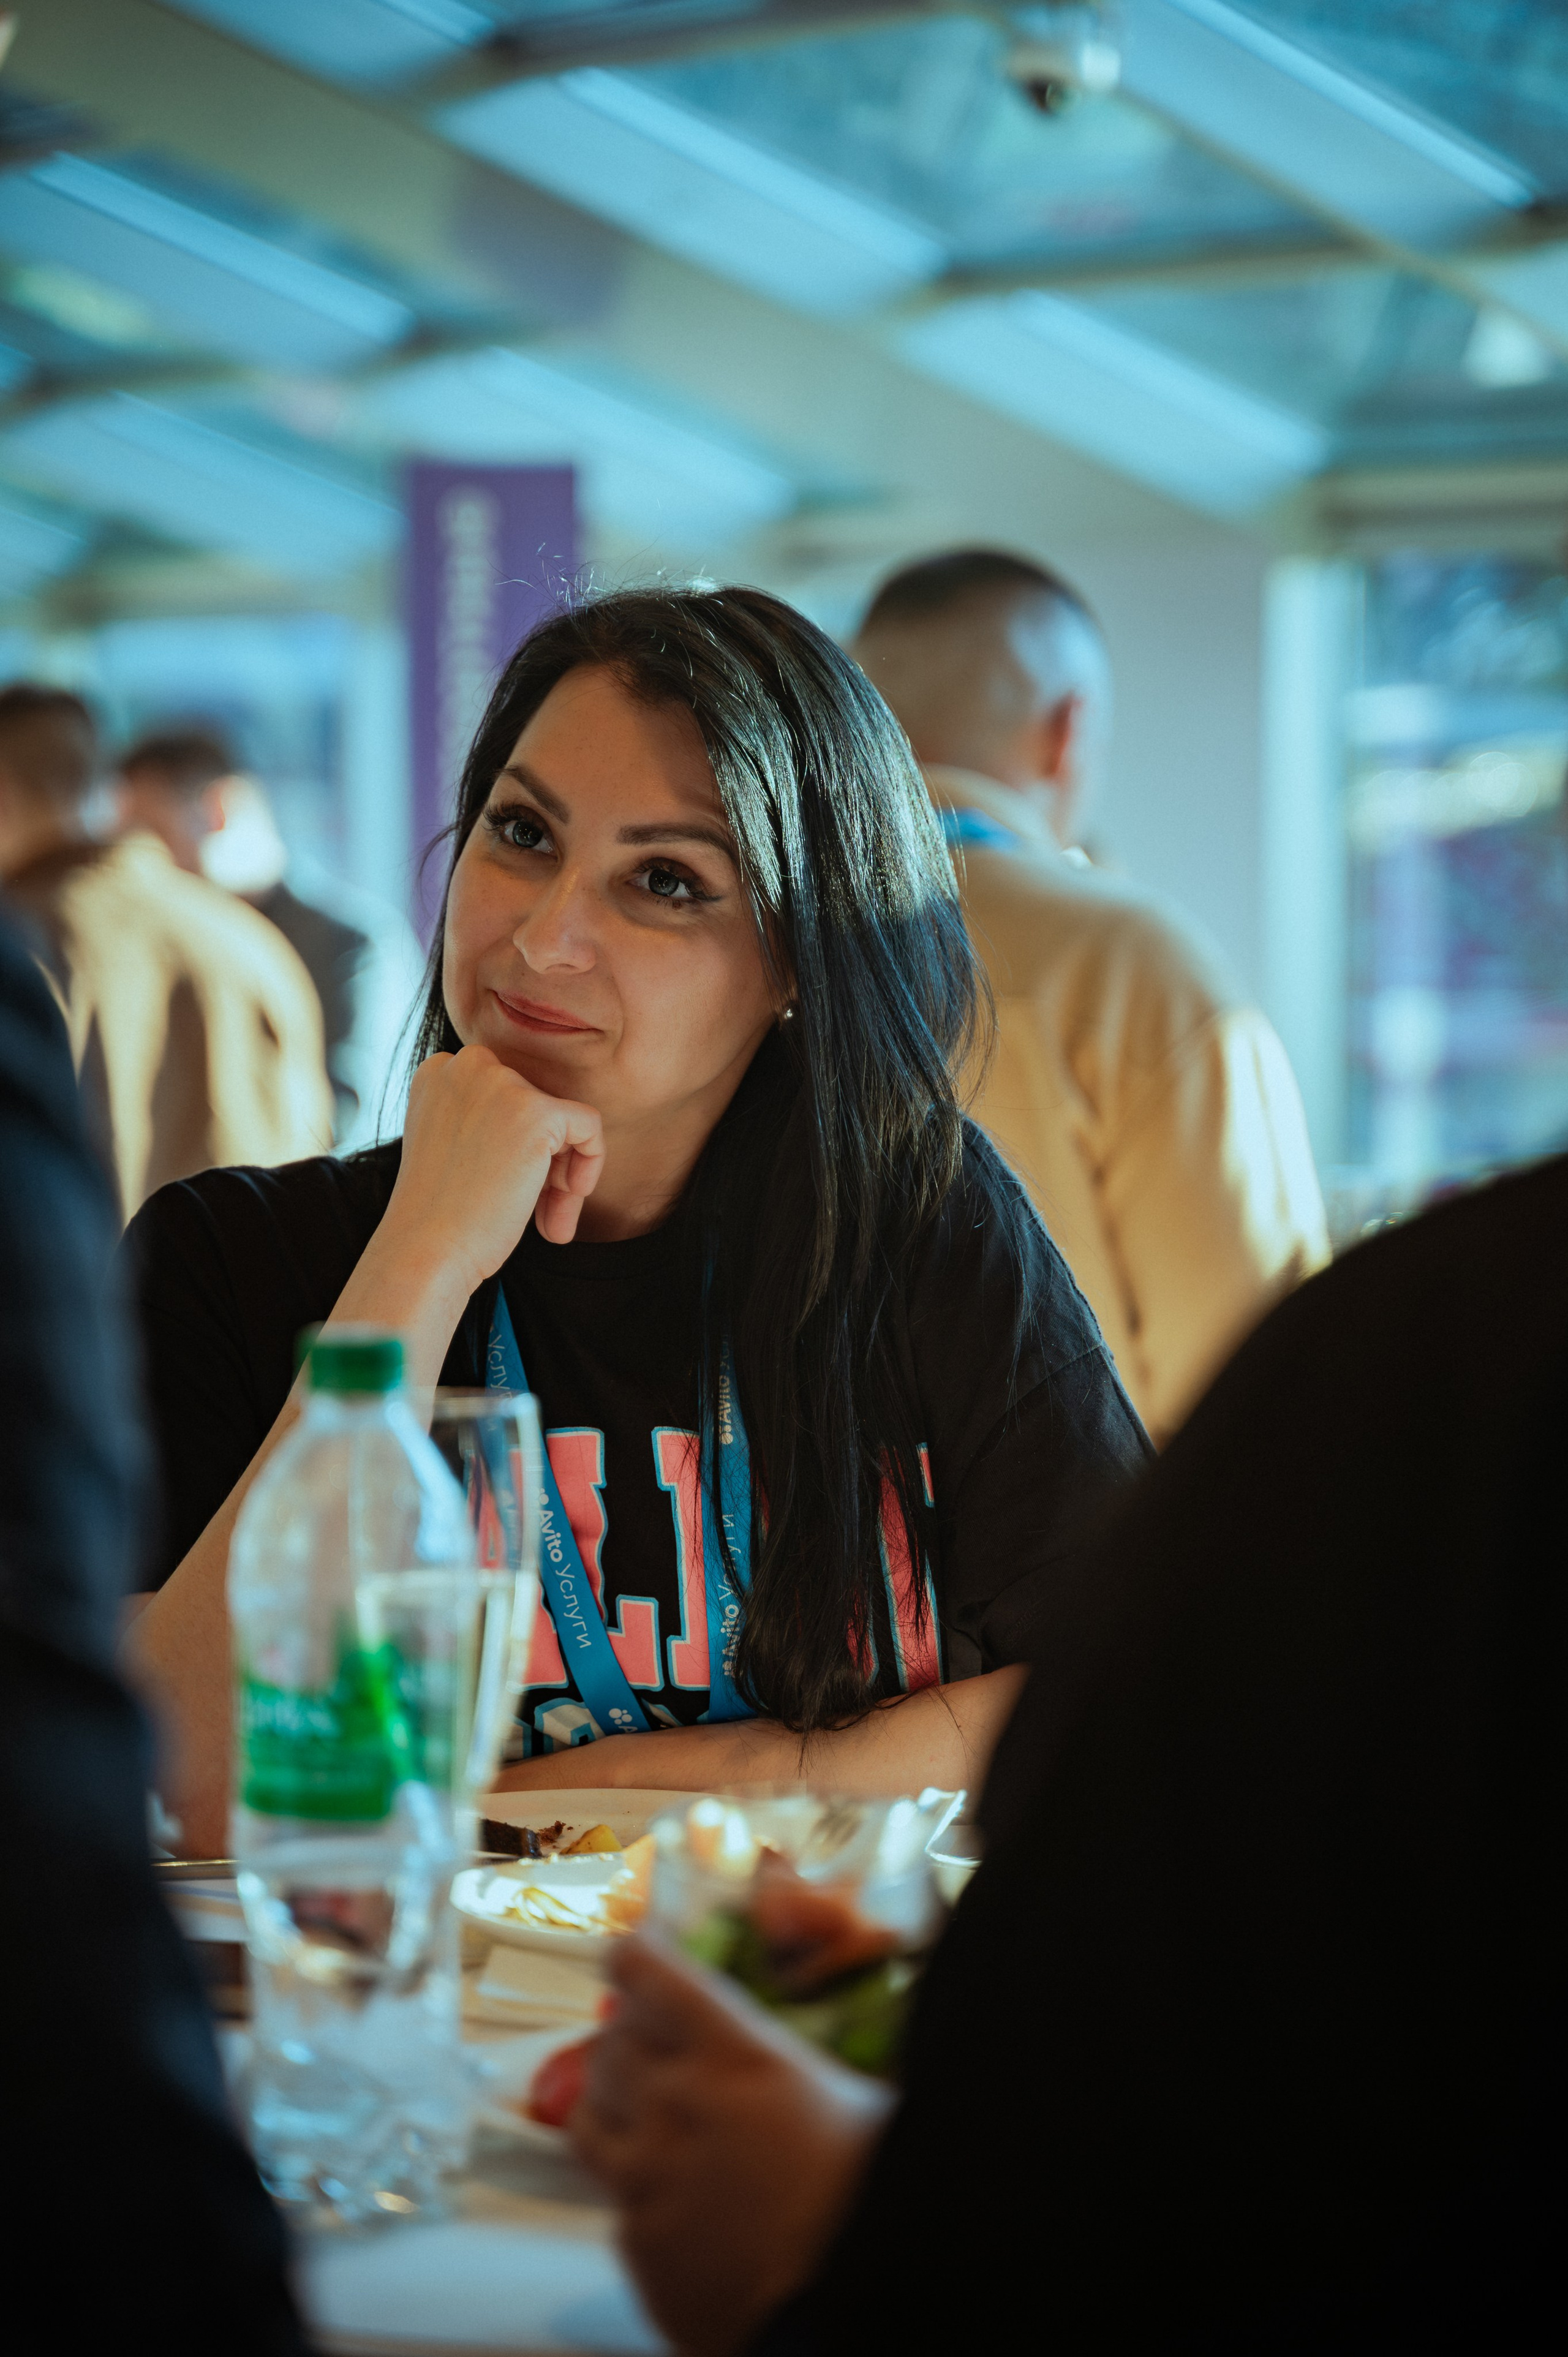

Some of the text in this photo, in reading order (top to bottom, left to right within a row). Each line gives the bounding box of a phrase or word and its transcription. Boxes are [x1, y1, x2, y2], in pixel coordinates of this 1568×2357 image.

[488, 1334, 514, 1403] Услуг
[539, 1509, 592, 1649] Avito Услуги
